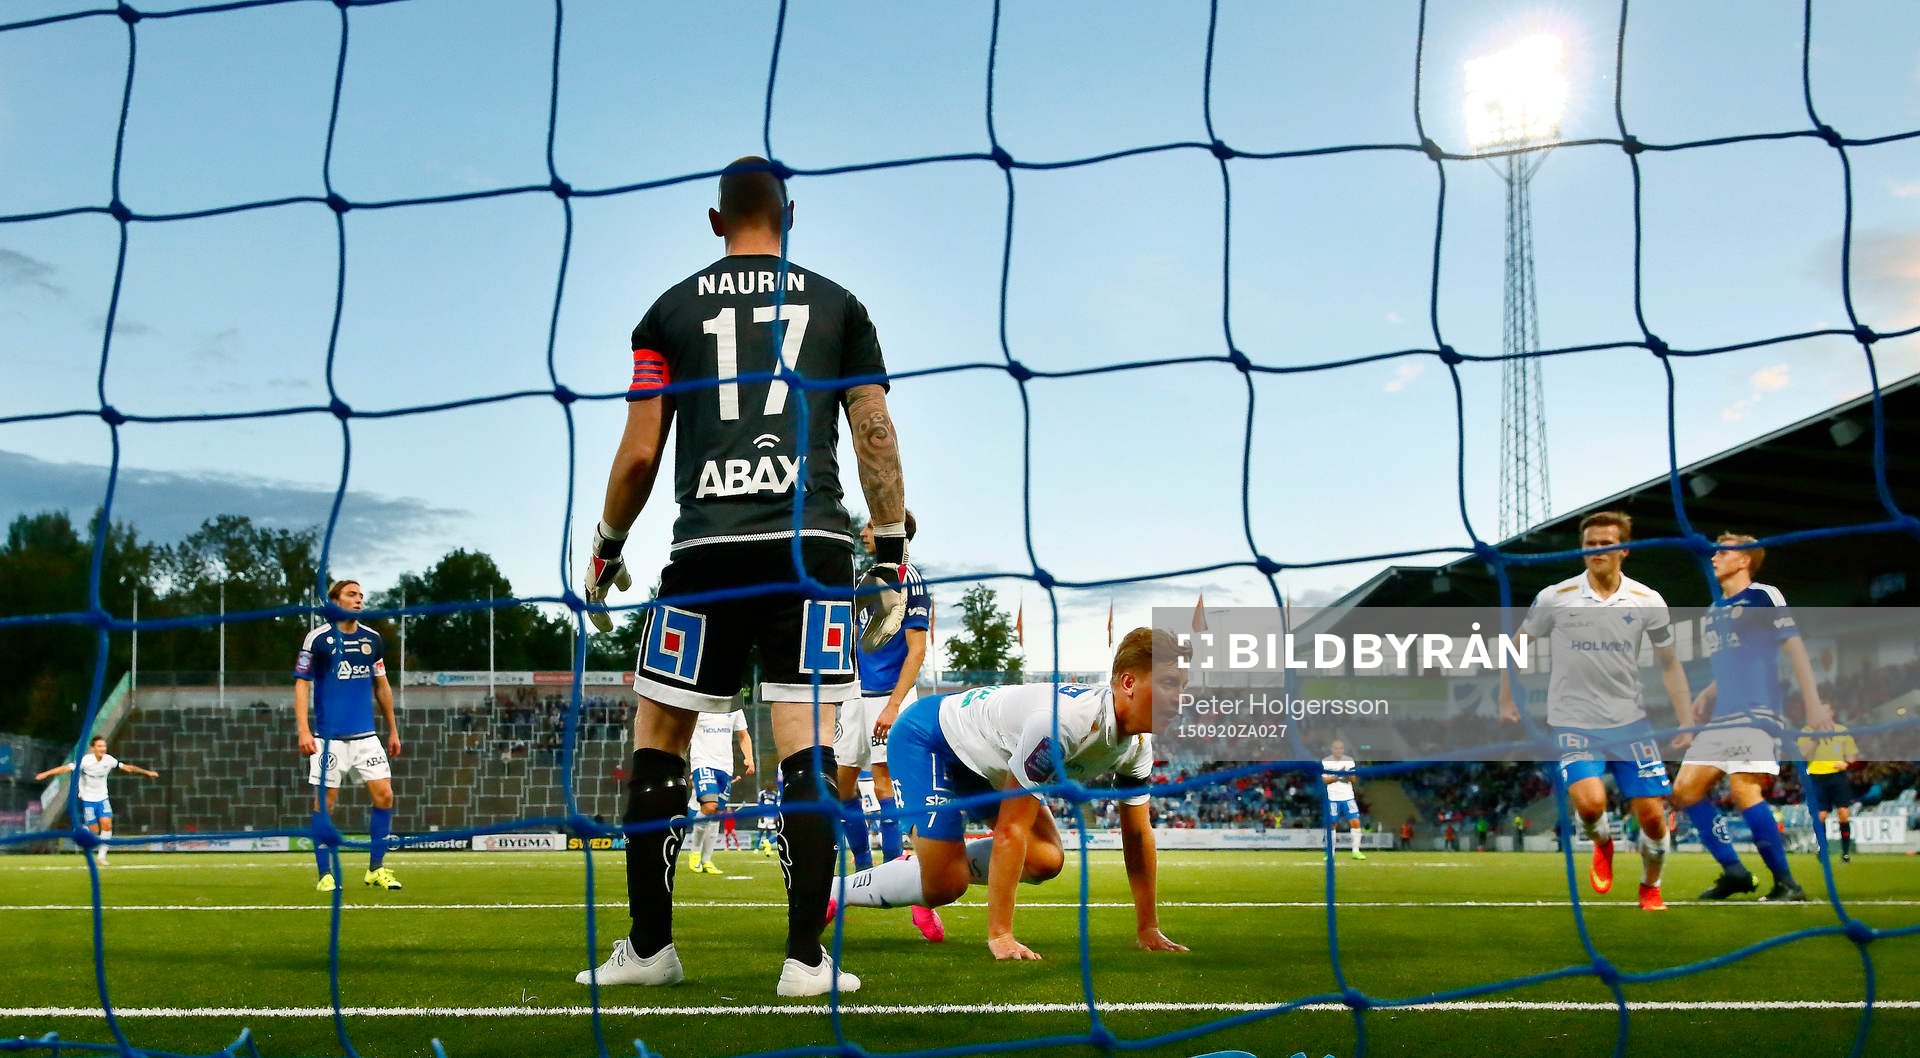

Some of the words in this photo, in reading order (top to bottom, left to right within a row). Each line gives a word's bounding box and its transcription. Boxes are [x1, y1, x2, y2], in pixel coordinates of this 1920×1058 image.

[698, 271, 805, 296] NAURIN
[702, 304, 810, 421] 17
[696, 455, 808, 499] ABAX
[352, 665, 371, 675] SCA
[927, 811, 937, 829] 7
[499, 838, 551, 849] BYGMA
